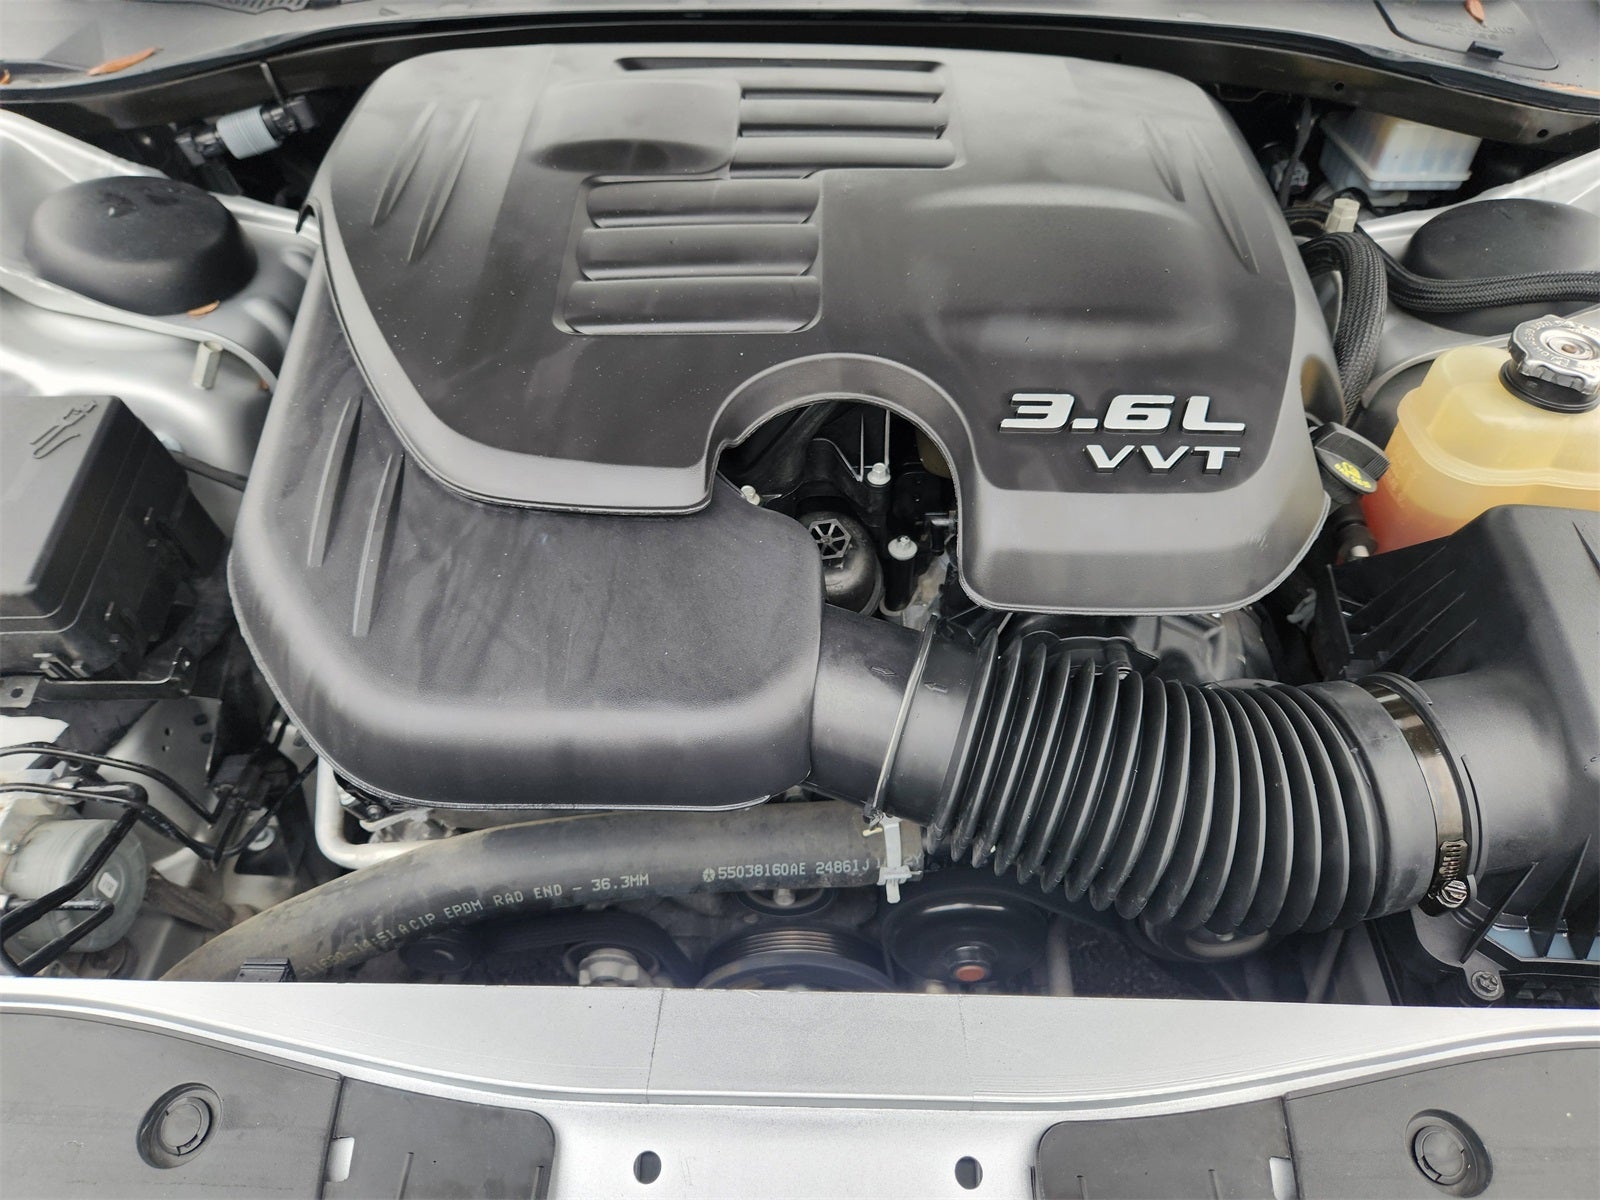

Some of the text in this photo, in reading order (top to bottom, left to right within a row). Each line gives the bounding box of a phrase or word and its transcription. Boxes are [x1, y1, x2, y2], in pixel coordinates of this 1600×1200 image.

[1000, 393, 1246, 436] 3.6L
[1083, 444, 1242, 473] VVT
[717, 862, 807, 880] 55038160AE
[443, 899, 483, 919] EPDM
[493, 891, 524, 907] RAD
[534, 884, 563, 899] END
[591, 873, 650, 892] 36.3MM
